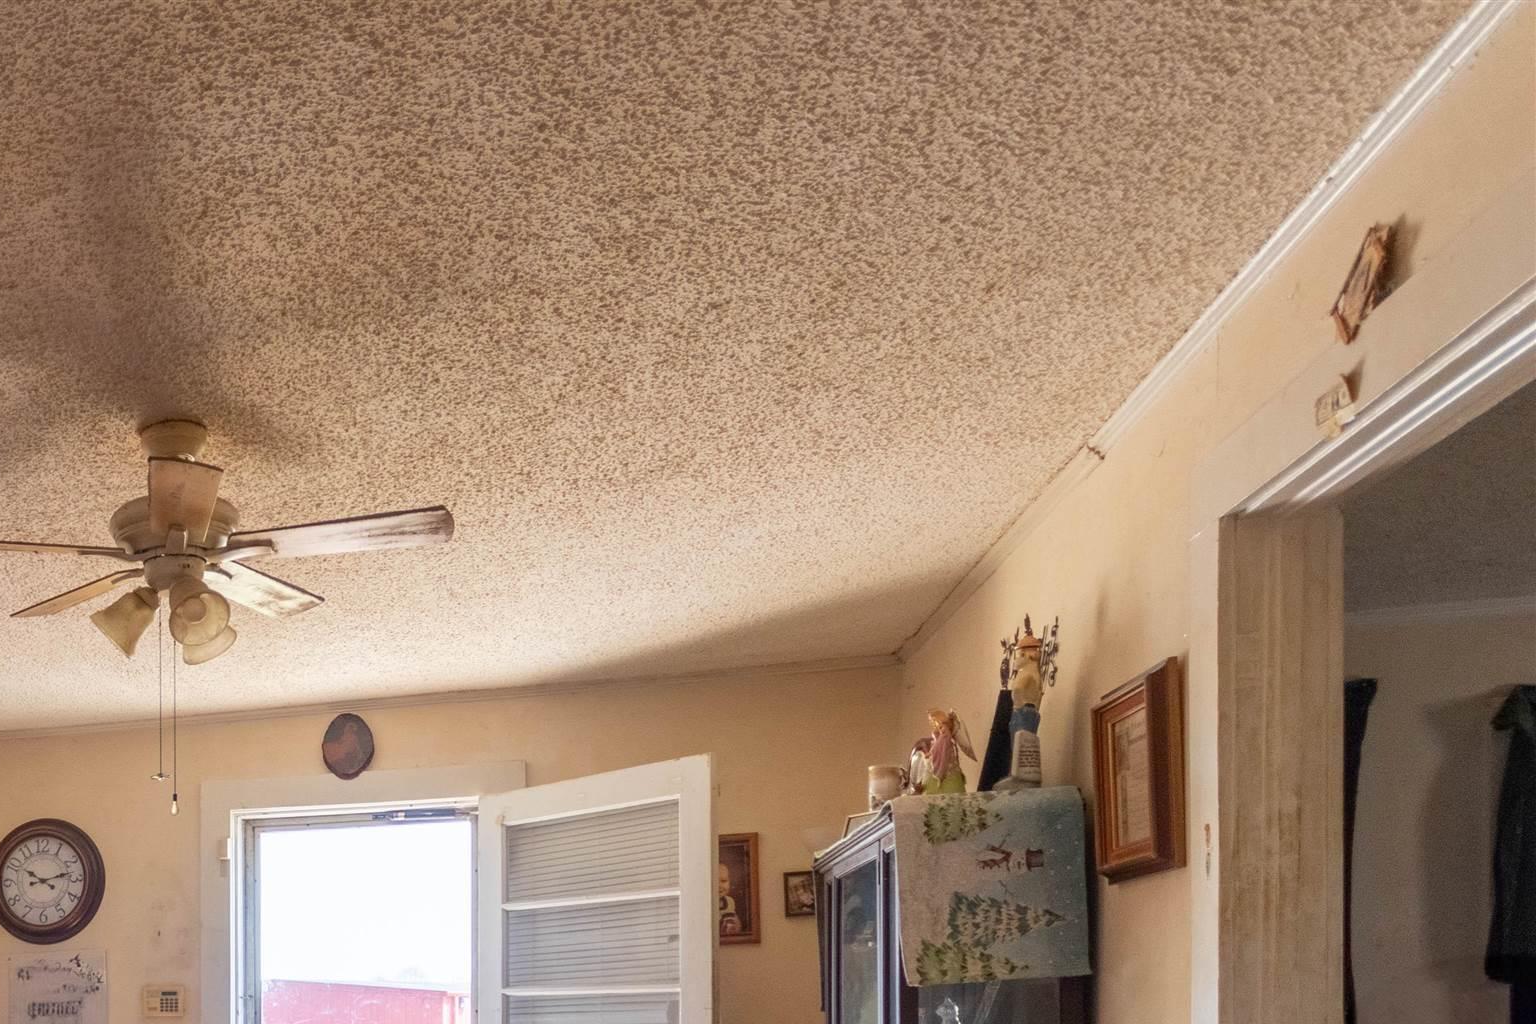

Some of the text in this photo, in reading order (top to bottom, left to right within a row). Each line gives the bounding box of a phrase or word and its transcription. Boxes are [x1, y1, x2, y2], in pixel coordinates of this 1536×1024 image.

[18, 844, 33, 860] 11
[36, 839, 49, 853] 12
[55, 842, 63, 856] 1
[7, 857, 24, 873] 10
[64, 855, 78, 868] 2
[3, 878, 17, 888] 9
[69, 873, 82, 884] 3
[8, 894, 21, 907] 8
[68, 892, 81, 903] 4
[22, 905, 33, 918] 7
[39, 907, 48, 924] 6
[55, 903, 66, 918] 5
